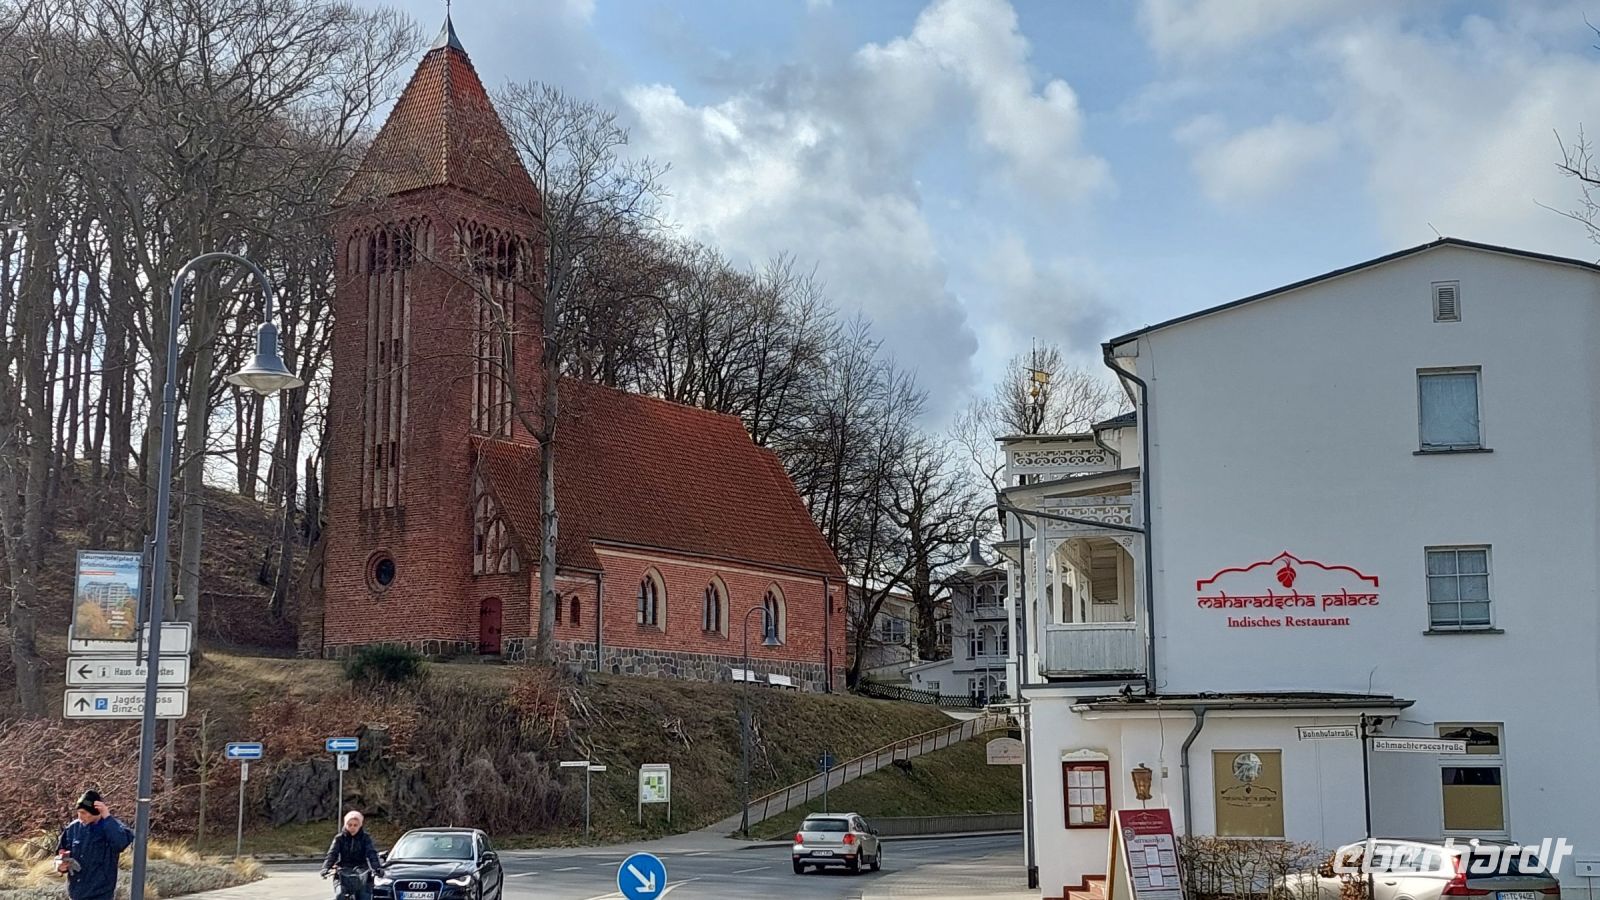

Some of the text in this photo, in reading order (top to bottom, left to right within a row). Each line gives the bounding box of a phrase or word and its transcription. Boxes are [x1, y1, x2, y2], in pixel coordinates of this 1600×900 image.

[1197, 588, 1380, 612] maharadscha palace
[1228, 616, 1350, 628] Indisches Restaurant
[114, 667, 132, 676] Haus
